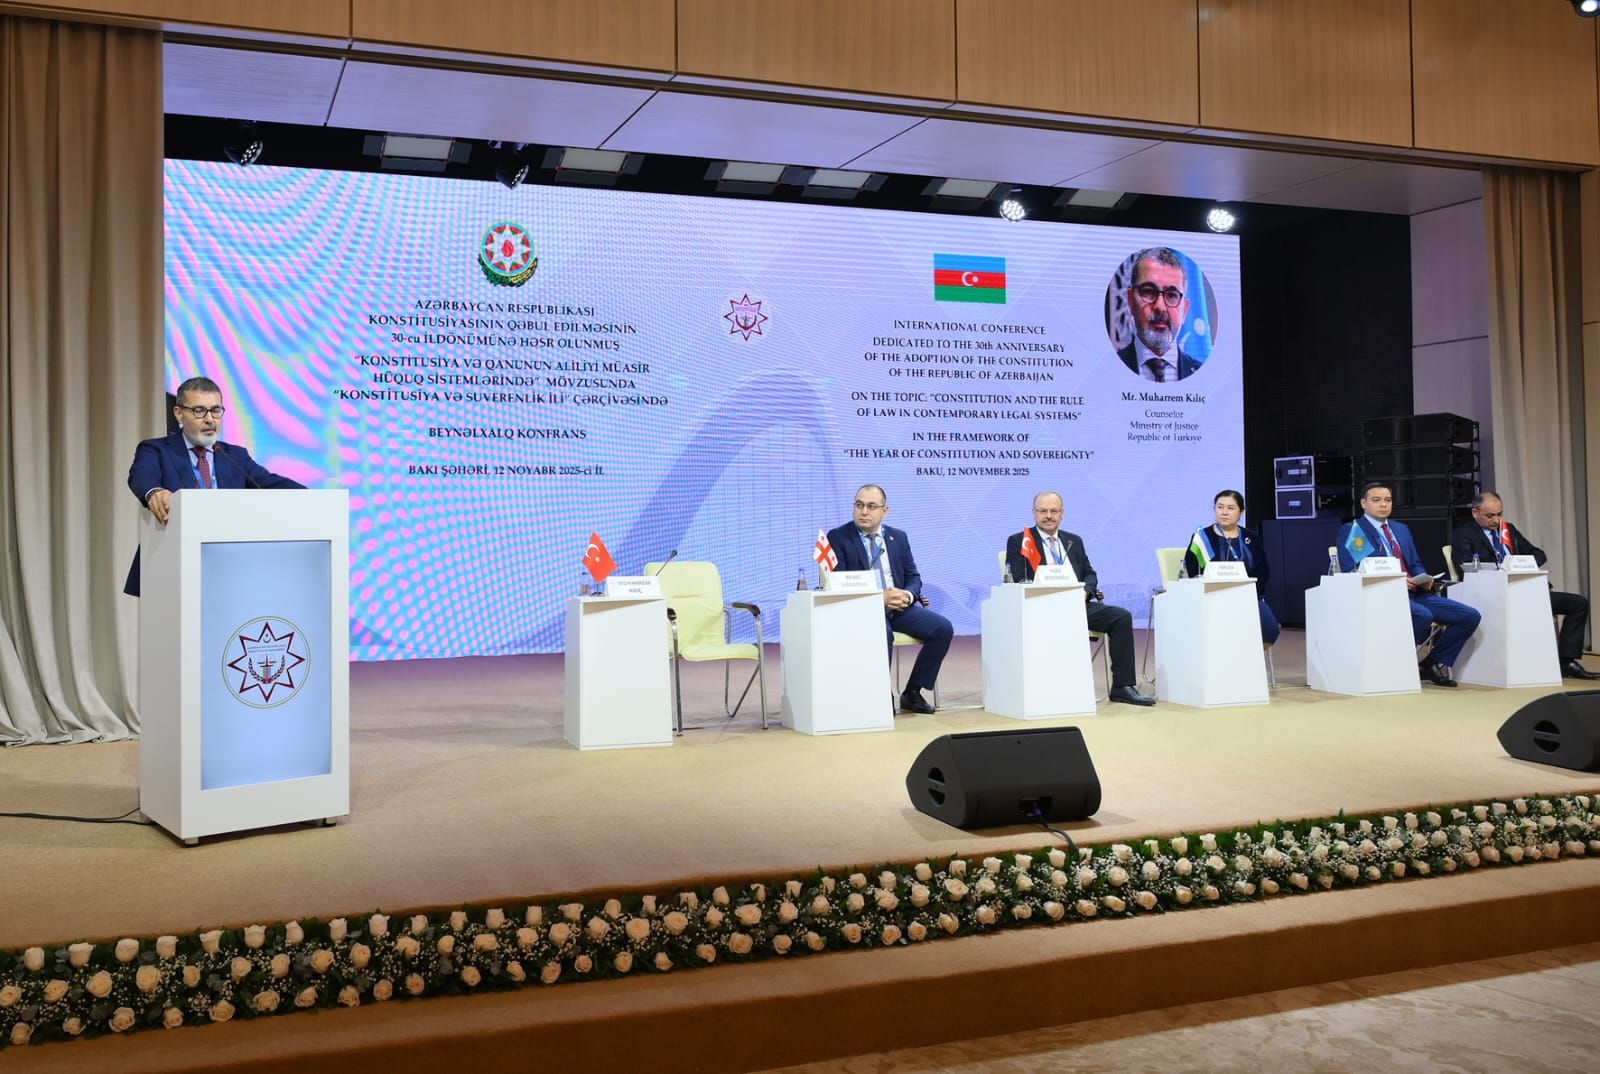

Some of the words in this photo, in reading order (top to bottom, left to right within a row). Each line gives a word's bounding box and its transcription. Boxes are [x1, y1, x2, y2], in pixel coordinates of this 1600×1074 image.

[415, 300, 504, 313] AZƏRBAYCAN
[507, 303, 595, 316] RESPUBLİKASI
[369, 314, 504, 329] KONSTİTUSİYASININ
[507, 320, 550, 331] QƏBUL
[554, 321, 636, 334] EDİLMƏSİNİN
[894, 320, 978, 332] INTERNATIONAL
[981, 324, 1046, 335] CONFERENCE
[391, 333, 420, 343] 30-cu
[424, 332, 517, 346] İLDÖNÜMÜNƏ
[520, 337, 554, 348] HƏSR
[557, 338, 620, 351] OLUNMUŞ
[873, 336, 934, 348] DEDICATED
[936, 339, 951, 349] TO
[953, 340, 972, 349] THE
[975, 341, 993, 350] 30th
[996, 342, 1065, 353] ANNIVERSARY
[464, 359, 481, 369] VƏ
[485, 359, 551, 370] QANUNUN
[555, 360, 599, 372] ALİLİYİ
[602, 360, 650, 373] MÜASİR
[864, 352, 879, 361] OF
[881, 352, 901, 362] THE
[904, 353, 959, 364] ADOPTION
[961, 355, 975, 364] OF
[977, 356, 996, 365] THE
[998, 356, 1073, 367] CONSTITUTION
[373, 371, 424, 385] HÜQUQ
[546, 376, 636, 388] MÖVZUSUNDA
[889, 367, 903, 377] OF
[905, 368, 925, 377] THE
[928, 369, 976, 379] REPUBLIC
[978, 370, 992, 379] OF
[994, 371, 1054, 382] AZERBAIJAN
[444, 391, 463, 402] VƏ
[466, 392, 545, 403] SUVERENLİK
[573, 393, 668, 407] ÇƏRÇİVƏSİNDƏ
[851, 391, 868, 401] ON
[871, 392, 891, 401] THE
[893, 392, 928, 402] TOPIC:
[1014, 395, 1036, 404] AND
[1038, 396, 1058, 405] THE
[1060, 396, 1084, 405] RULE
[1121, 392, 1137, 401] Mr.
[1139, 392, 1184, 402] Muharrem
[857, 407, 871, 417] OF
[873, 407, 897, 417] LAW
[899, 408, 911, 417] IN
[913, 409, 999, 419] CONTEMPORARY
[1001, 410, 1032, 420] LEGAL
[1144, 409, 1184, 418] Counselor
[1130, 421, 1162, 431] Ministry
[1164, 421, 1172, 429] of
[1174, 421, 1199, 431] Justice
[428, 427, 514, 440] BEYNƏLXALQ
[517, 428, 587, 439] KONFRANS
[912, 432, 924, 441] IN
[927, 432, 947, 441] THE
[949, 433, 1015, 442] FRAMEWORK
[1016, 433, 1030, 442] OF
[1127, 432, 1161, 443] Republic
[1162, 433, 1170, 441] of
[872, 449, 899, 458] YEAR
[901, 449, 915, 458] OF
[917, 449, 996, 459] CONSTITUTION
[998, 450, 1020, 459] AND
[408, 465, 438, 475] BAKI
[441, 463, 491, 477] ŞƏHƏRİ,
[494, 466, 505, 475] 12
[507, 466, 557, 476] NOYABR
[558, 466, 592, 476] 2025-ci
[595, 464, 605, 475] İL
[916, 467, 945, 477] BAKU,
[947, 467, 957, 476] 12
[958, 467, 1011, 476] NOVEMBER
[1012, 467, 1030, 476] 2025
